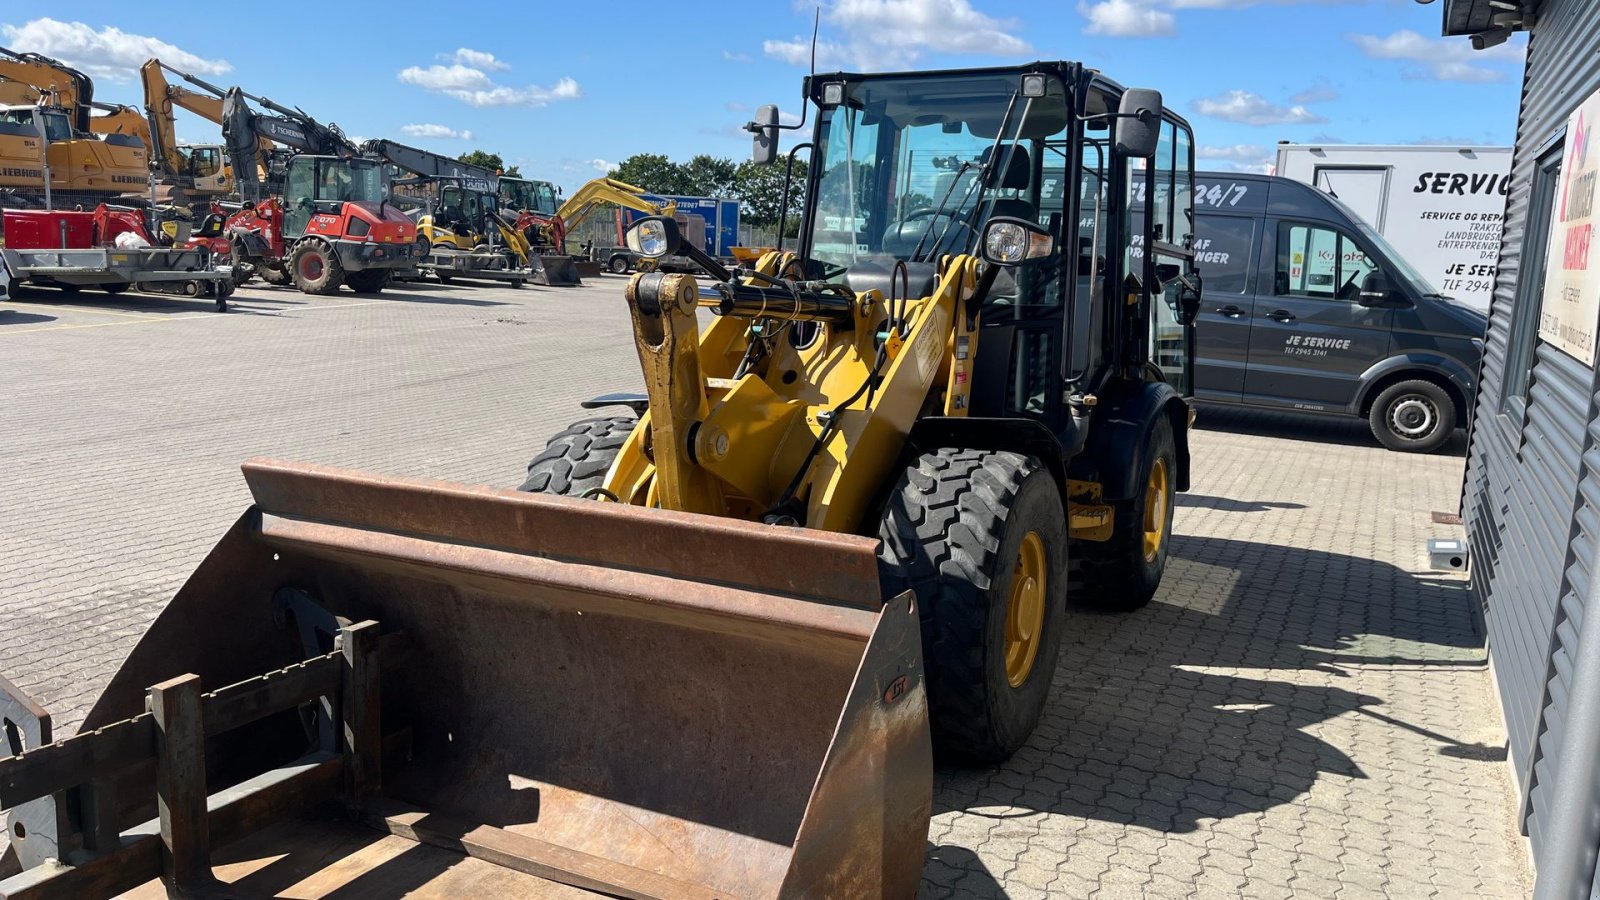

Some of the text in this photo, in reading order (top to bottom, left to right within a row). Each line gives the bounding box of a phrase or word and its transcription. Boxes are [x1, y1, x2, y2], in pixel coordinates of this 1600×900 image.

[0, 167, 42, 178] IEBHERR
[1194, 183, 1248, 208] 24/7
[1420, 211, 1462, 221] SERVICE
[1464, 213, 1478, 221] OG
[1319, 250, 1364, 261] Kuota
[1445, 264, 1466, 275] JE
[1443, 279, 1493, 293] TLF 294
[1286, 335, 1351, 350] JE SERVICE
[1284, 346, 1294, 354] TLF
[1295, 347, 1312, 356] 2945
